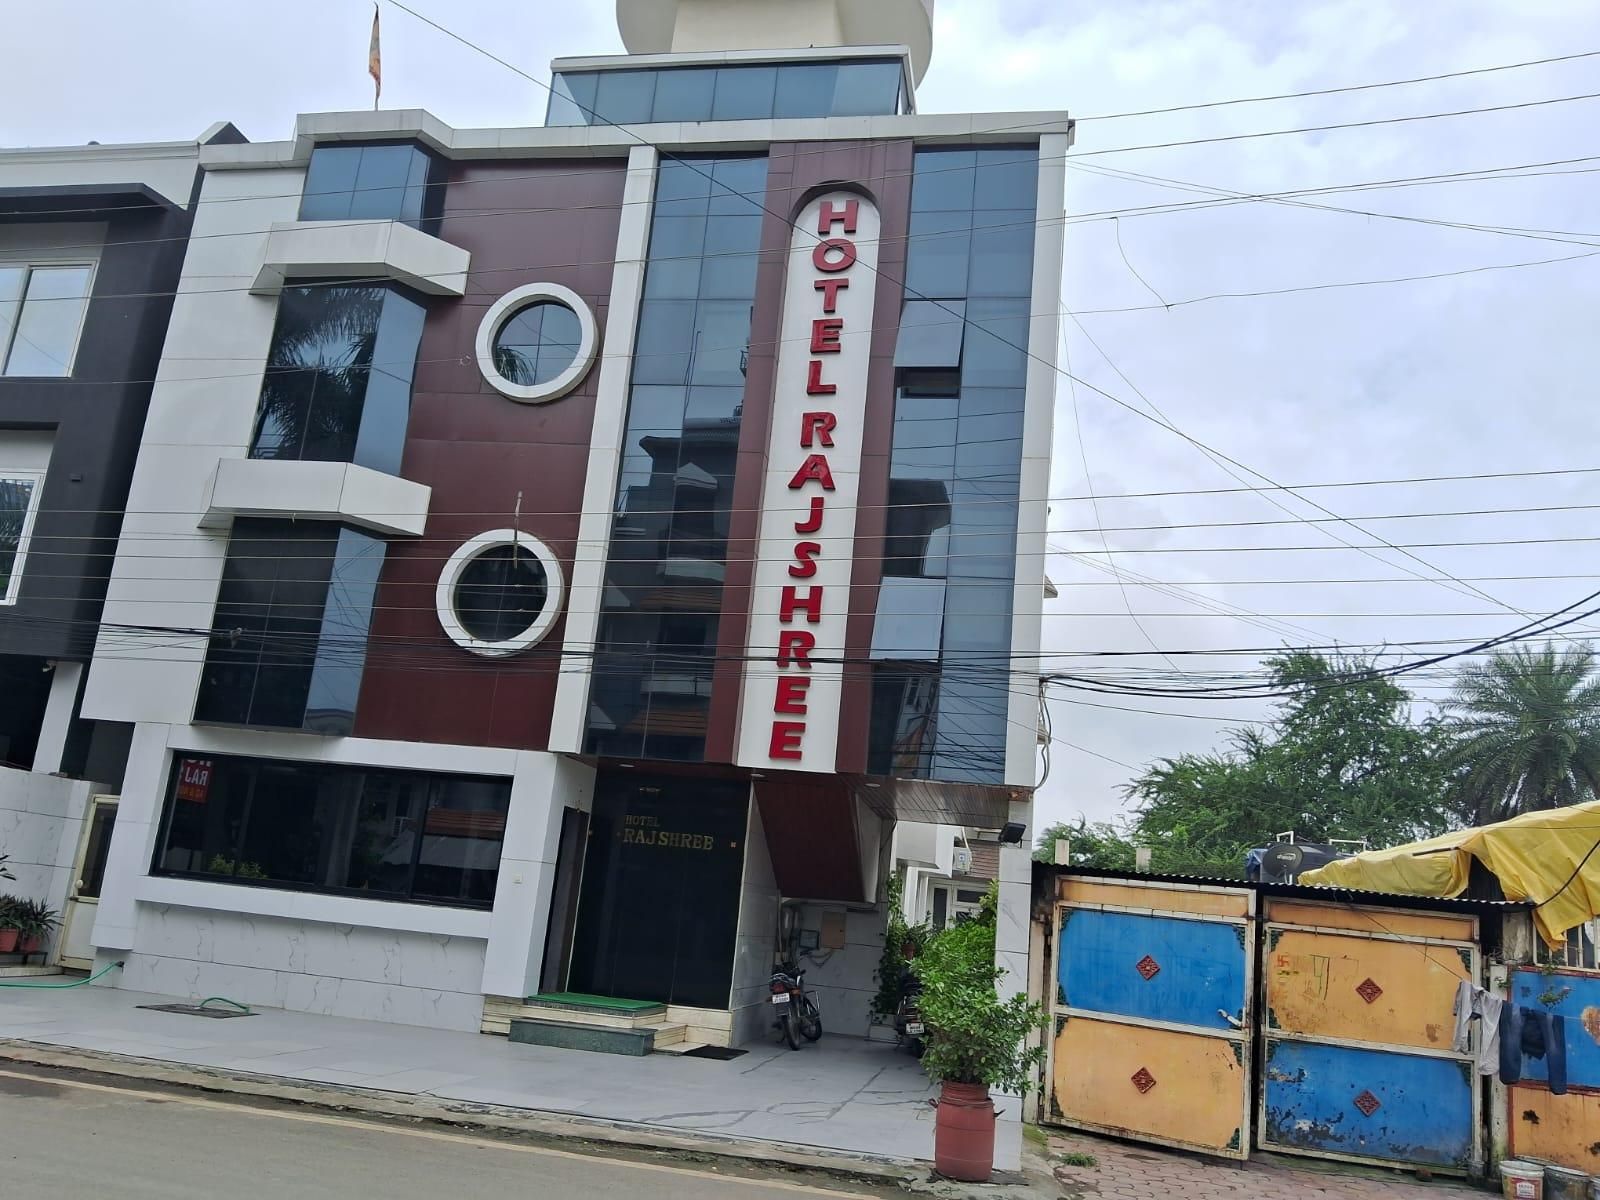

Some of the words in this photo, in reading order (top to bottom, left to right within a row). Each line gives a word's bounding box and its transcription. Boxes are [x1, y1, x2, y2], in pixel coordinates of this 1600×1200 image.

[806, 199, 859, 396] HOTEL
[768, 411, 838, 761] RAJSHREE
[623, 828, 713, 850] RAJSHREE
[625, 815, 659, 827] HOTEL
